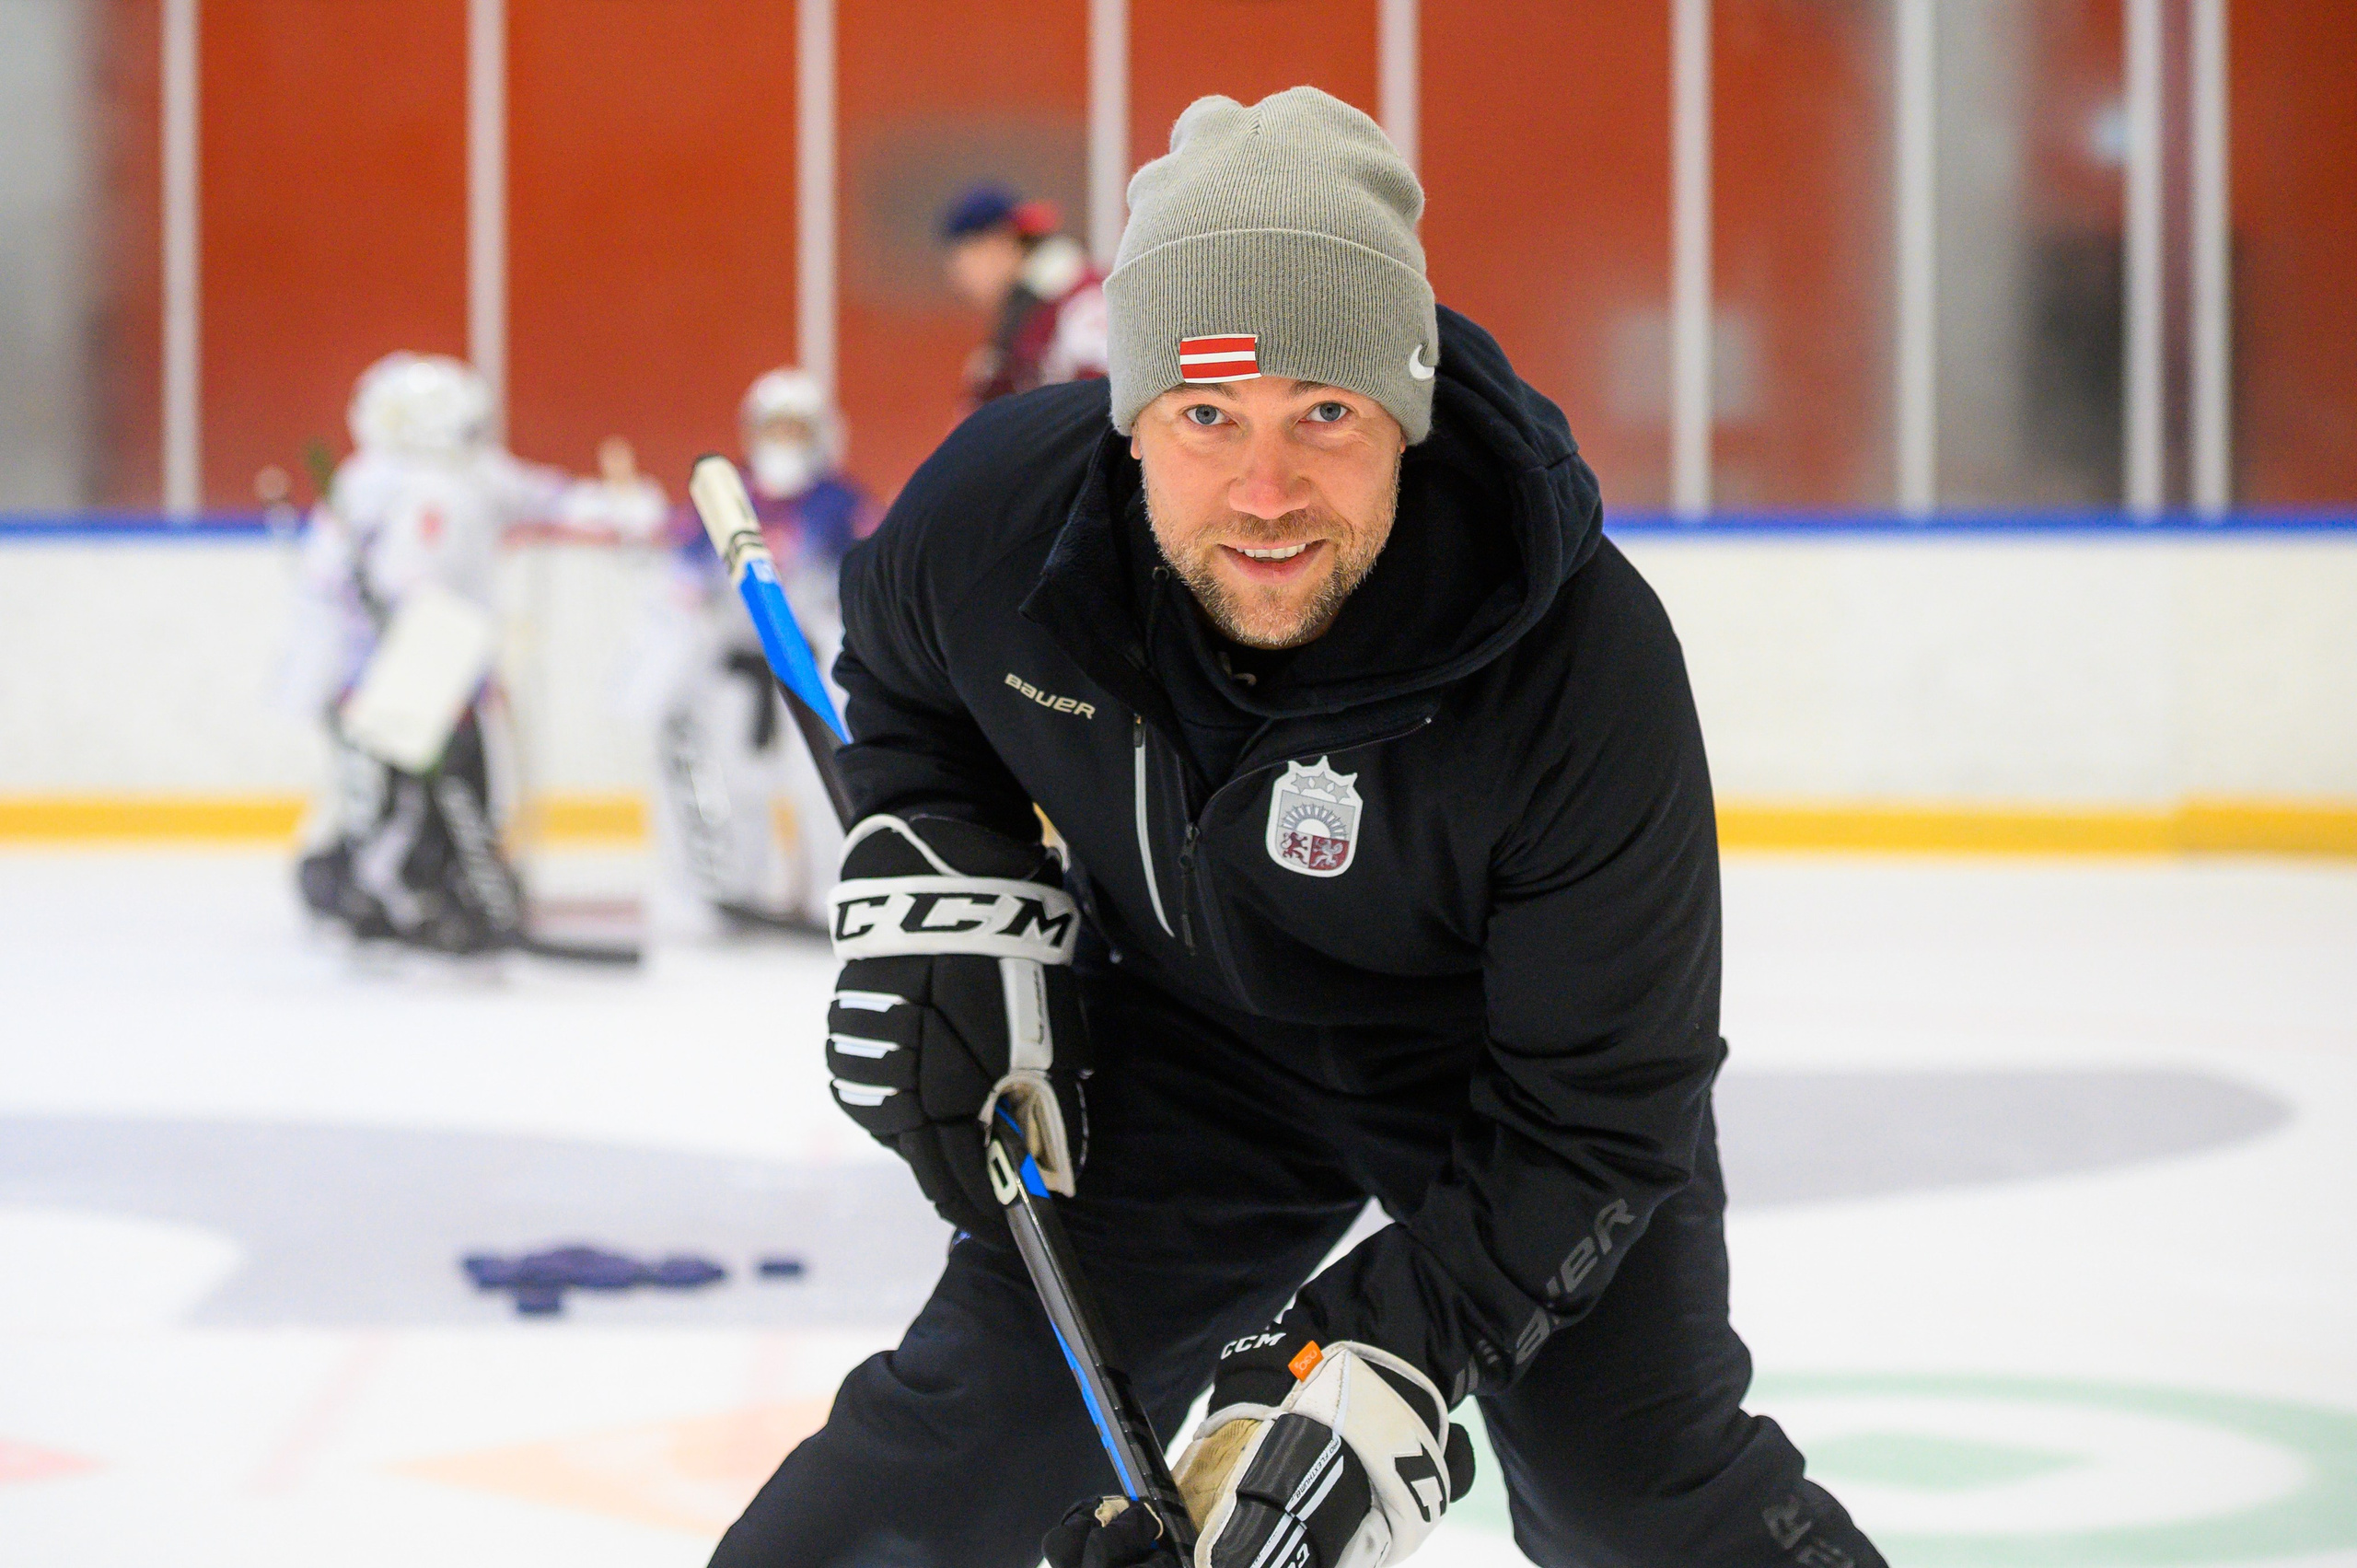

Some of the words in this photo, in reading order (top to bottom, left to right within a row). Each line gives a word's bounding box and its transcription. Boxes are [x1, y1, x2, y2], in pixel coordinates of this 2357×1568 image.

[1004, 673, 1096, 719] BAUER
[836, 892, 1074, 948] CCM
[1220, 1332, 1287, 1360] CCM
